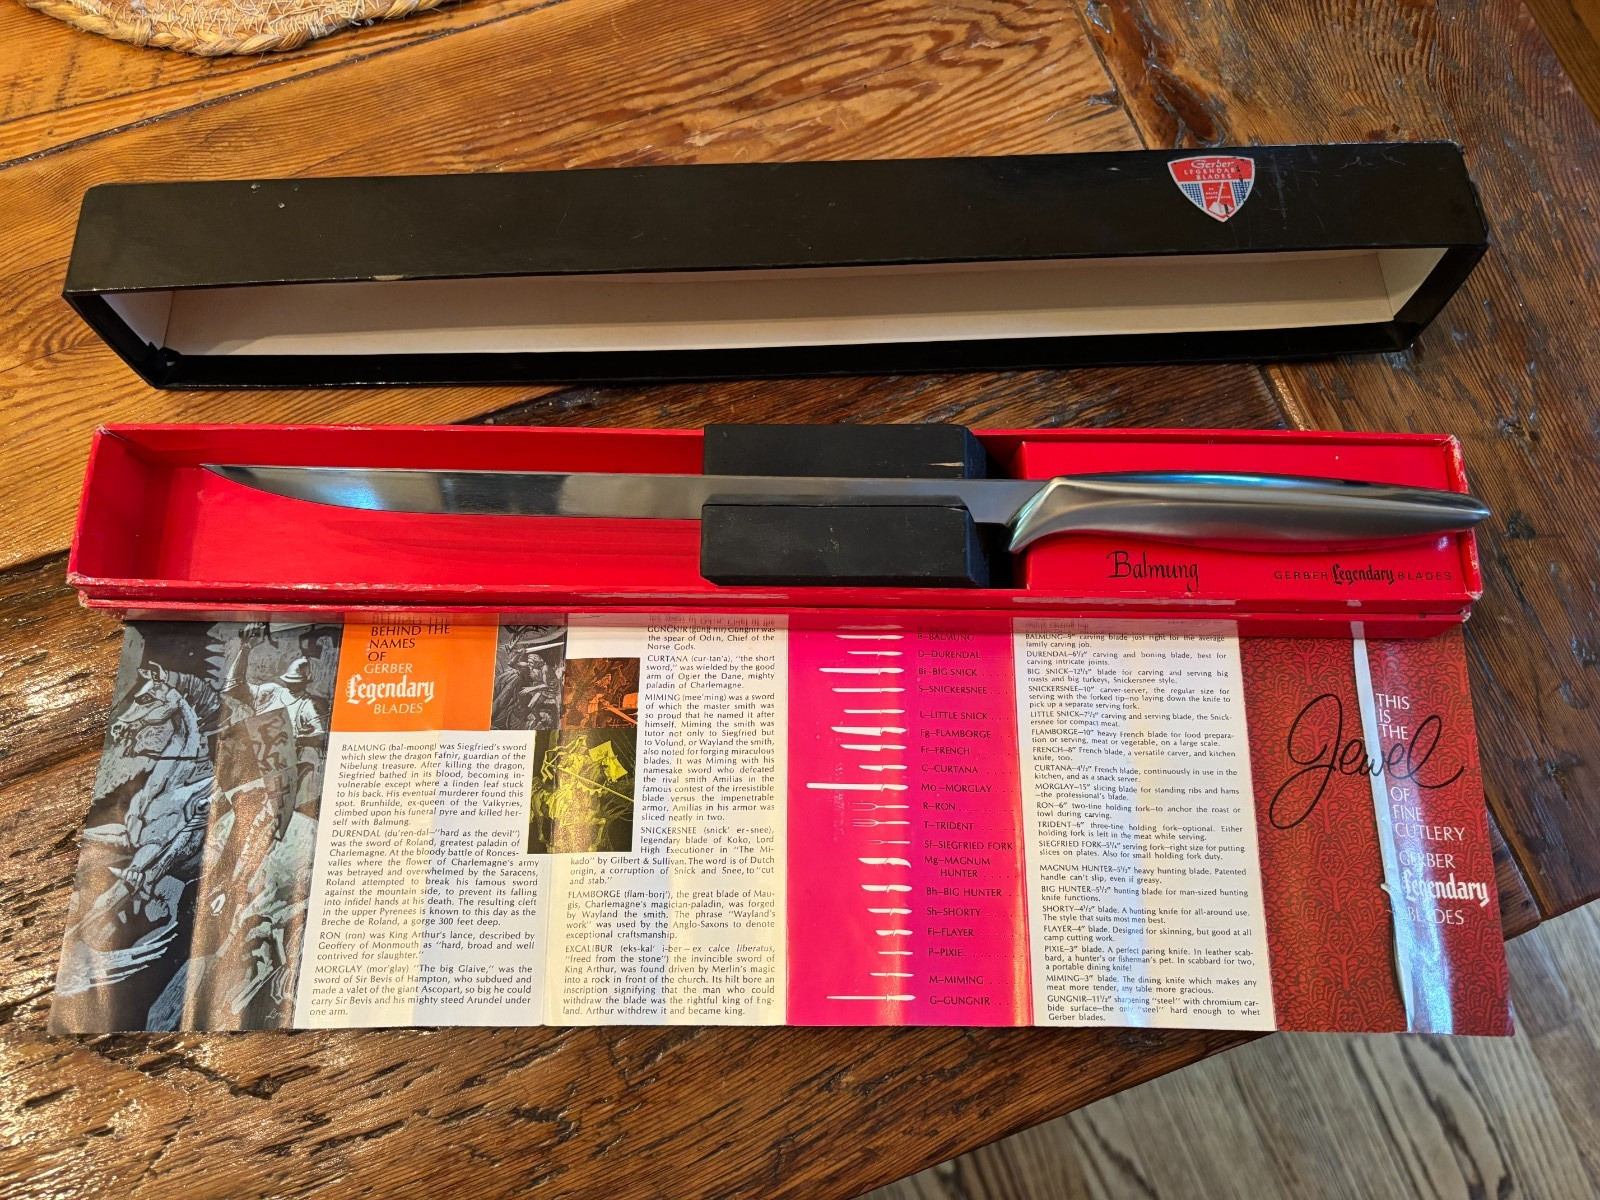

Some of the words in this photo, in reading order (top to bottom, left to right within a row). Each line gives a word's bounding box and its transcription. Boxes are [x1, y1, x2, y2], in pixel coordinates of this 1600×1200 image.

[1191, 159, 1235, 169] Gerber
[1184, 167, 1240, 175] LEGENDAR
[1106, 551, 1199, 592] Balmung
[1274, 571, 1329, 581] GERBER
[1332, 563, 1395, 585] Legendary
[1398, 572, 1453, 581] BLADES
[371, 626, 422, 637] BEHIND
[427, 624, 450, 635] THE
[369, 638, 416, 649] NAMES
[368, 651, 386, 662] OF
[364, 663, 413, 674] GERBER
[696, 663, 728, 671] wielded
[729, 664, 739, 672] by
[756, 663, 775, 671] good
[950, 668, 977, 676] SNICK
[678, 673, 700, 681] Ogier
[748, 672, 775, 680] mighty
[346, 673, 434, 705] Legendary
[646, 681, 675, 689] paladin
[690, 681, 743, 690] Charlemagne.
[1376, 693, 1410, 710] THIS
[374, 703, 423, 714] BLADES
[961, 712, 988, 720] SNICK
[1379, 708, 1391, 723] IS
[1379, 724, 1409, 739] THE
[389, 743, 436, 751] (bal-moong)
[502, 743, 527, 751] sword
[389, 752, 402, 760] the
[404, 752, 431, 760] dragon
[435, 751, 460, 760] Fafnir,
[463, 752, 499, 760] guardian
[513, 752, 526, 760] the
[1269, 693, 1465, 829] Jewel
[340, 762, 378, 770] Nibelung
[445, 761, 472, 770] killing
[476, 761, 490, 769] the
[494, 762, 525, 770] dragon,
[338, 771, 375, 780] Siegfried
[379, 771, 407, 779] bathed
[436, 770, 463, 779] blood,
[467, 771, 509, 780] becoming
[1390, 787, 1410, 801] OF
[1393, 804, 1423, 821] FINE
[1395, 823, 1465, 841] CUTLERY
[988, 842, 1012, 850] FORK
[1399, 851, 1456, 869] GERBER
[940, 869, 978, 878] HUNTER
[964, 888, 1002, 896] HUNTER
[1098, 905, 1119, 913] blade.
[1129, 907, 1156, 916] hunting
[1159, 907, 1178, 915] knife
[1408, 907, 1465, 925] BLDES
[1043, 913, 1057, 921] The
[1059, 914, 1077, 922] style
[345, 932, 365, 940] (ron)
[389, 931, 408, 940] King
[450, 930, 475, 940] lance,
[479, 931, 521, 939] described
[525, 931, 535, 941] by
[318, 941, 355, 951] Geoffery
[359, 941, 369, 949] of
[372, 940, 419, 949] Monmouth
[467, 941, 493, 949] broad
[496, 941, 512, 949] and
[516, 941, 534, 949] well
[317, 951, 358, 960] contrived
[362, 951, 374, 959] for
[564, 986, 607, 995] inscription
[614, 985, 656, 995] signifying
[661, 985, 677, 993] that
[683, 985, 696, 993] the
[727, 985, 745, 993] who
[752, 985, 774, 993] could
[563, 996, 602, 1004] withdraw
[606, 996, 619, 1004] the
[623, 996, 647, 1005] blade
[670, 996, 683, 1004] the
[687, 996, 718, 1005] rightful
[722, 996, 740, 1005] king
[744, 996, 753, 1004] of
[563, 1006, 582, 1014] land.
[586, 1006, 614, 1014] Arthur
[617, 1006, 657, 1015] withdrew
[670, 1006, 685, 1014] and
[688, 1006, 721, 1014] became
[725, 1006, 745, 1016] king.
